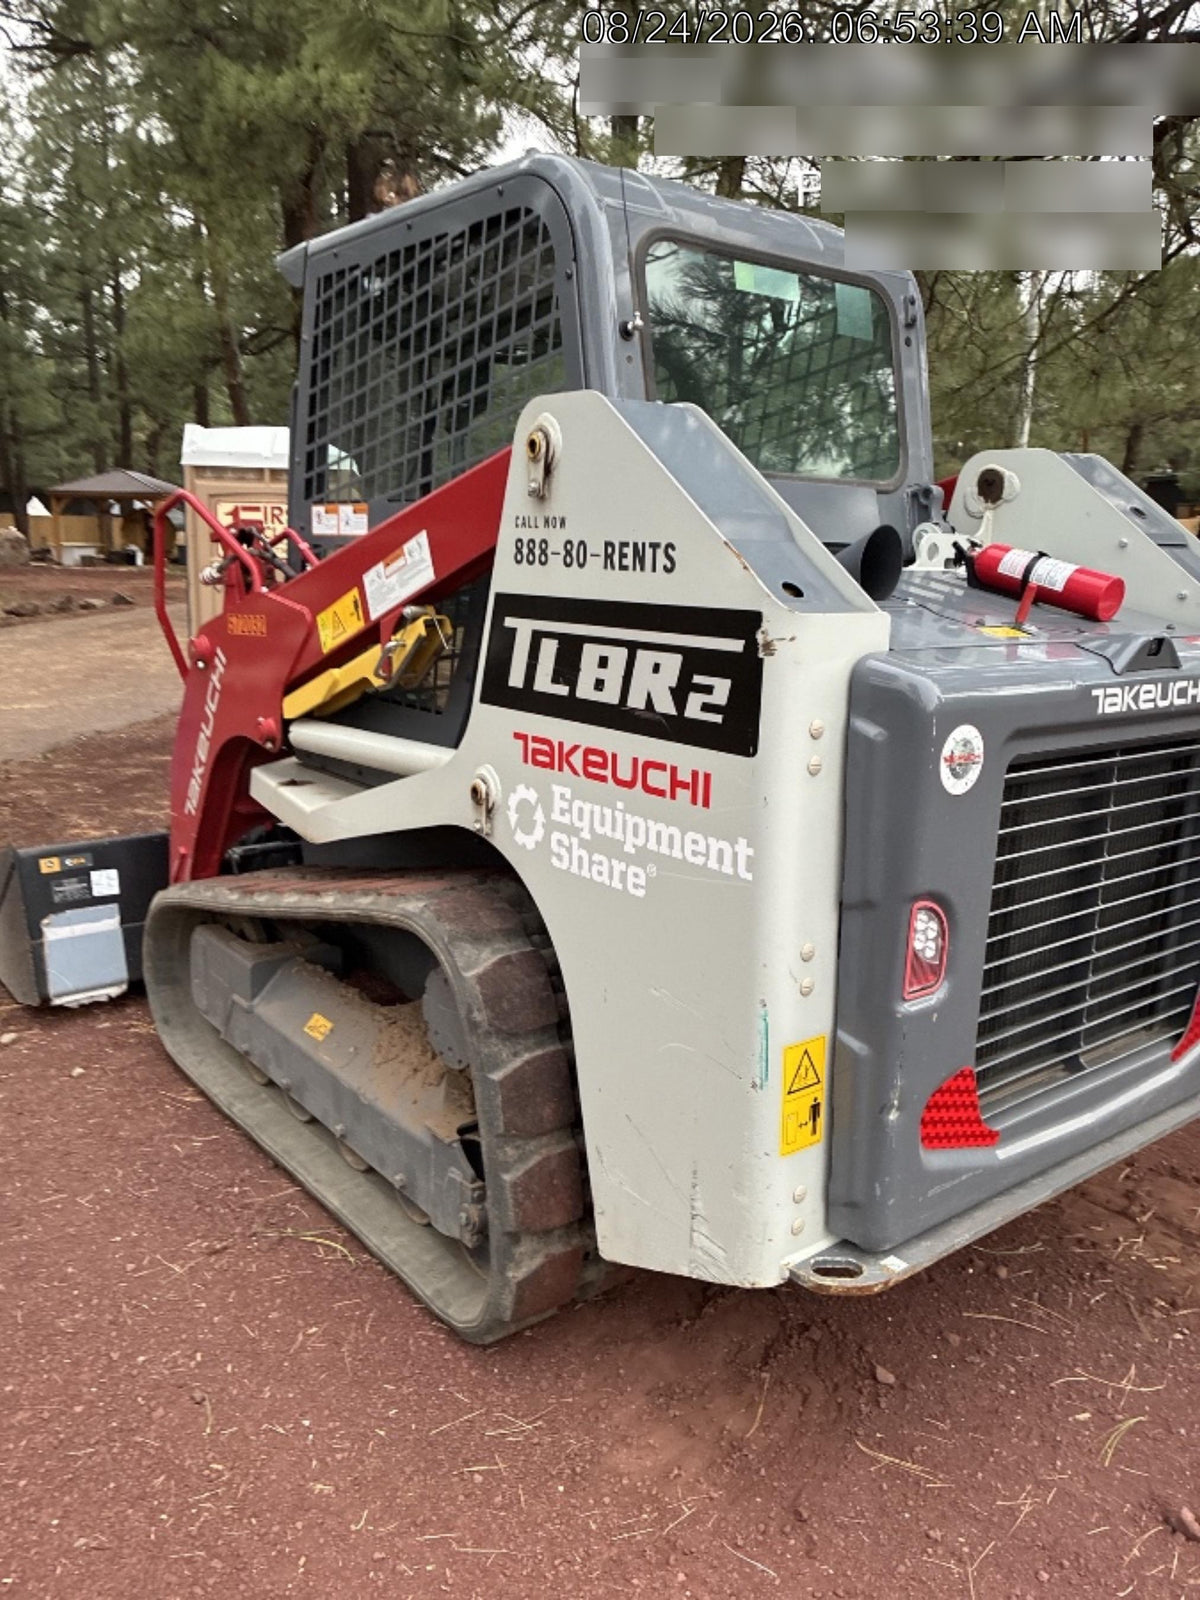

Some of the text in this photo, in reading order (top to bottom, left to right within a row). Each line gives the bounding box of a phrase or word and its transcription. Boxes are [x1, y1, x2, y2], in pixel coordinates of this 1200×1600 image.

[515, 515, 567, 530] CALL NOW
[514, 537, 677, 574] 888-80-RENTS
[503, 616, 746, 724] TL8R2
[1091, 679, 1200, 715] TAKEUCH
[513, 731, 712, 809] TAKEUCHI
[550, 783, 755, 881] Equipment
